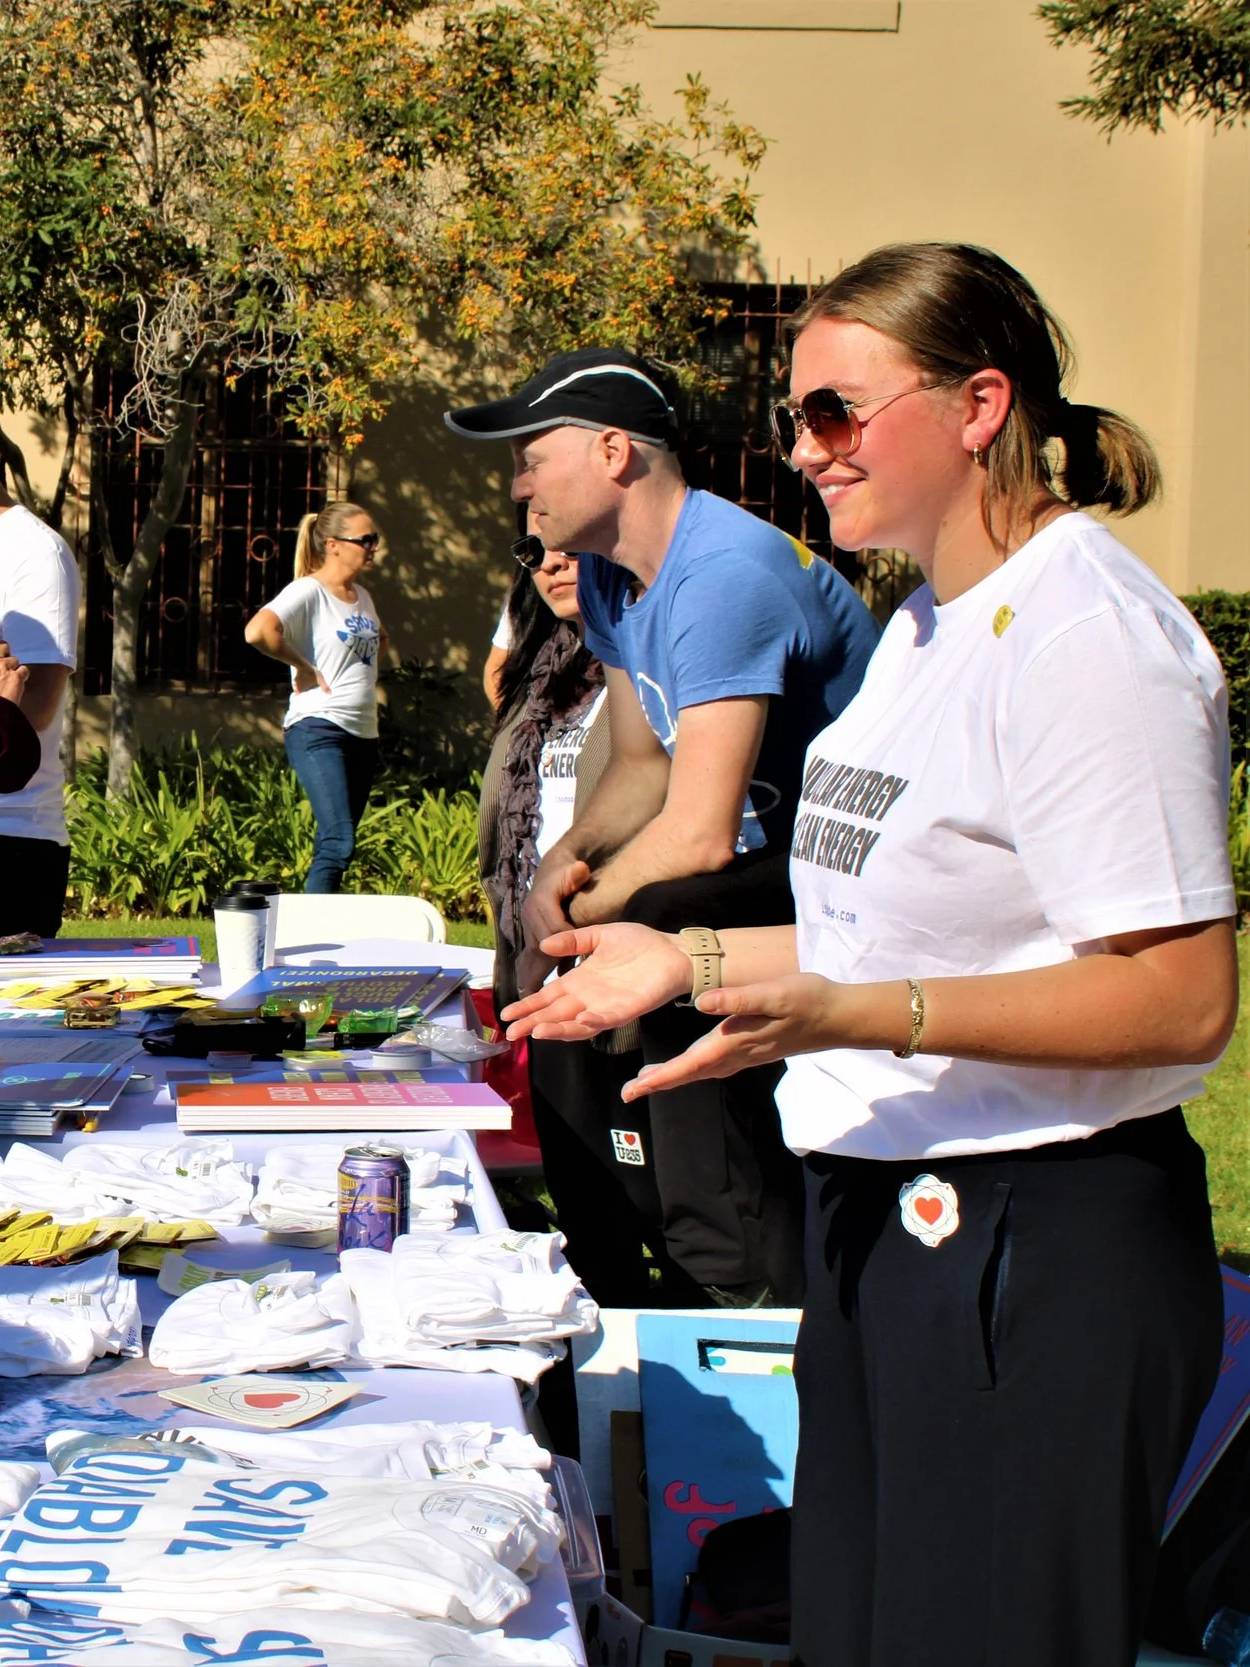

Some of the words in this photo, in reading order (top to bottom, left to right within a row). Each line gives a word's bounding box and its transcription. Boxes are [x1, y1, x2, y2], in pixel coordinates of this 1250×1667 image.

[542, 753, 575, 778] ENER
[831, 767, 910, 822] ENERGY
[815, 818, 882, 878] ENERGY
